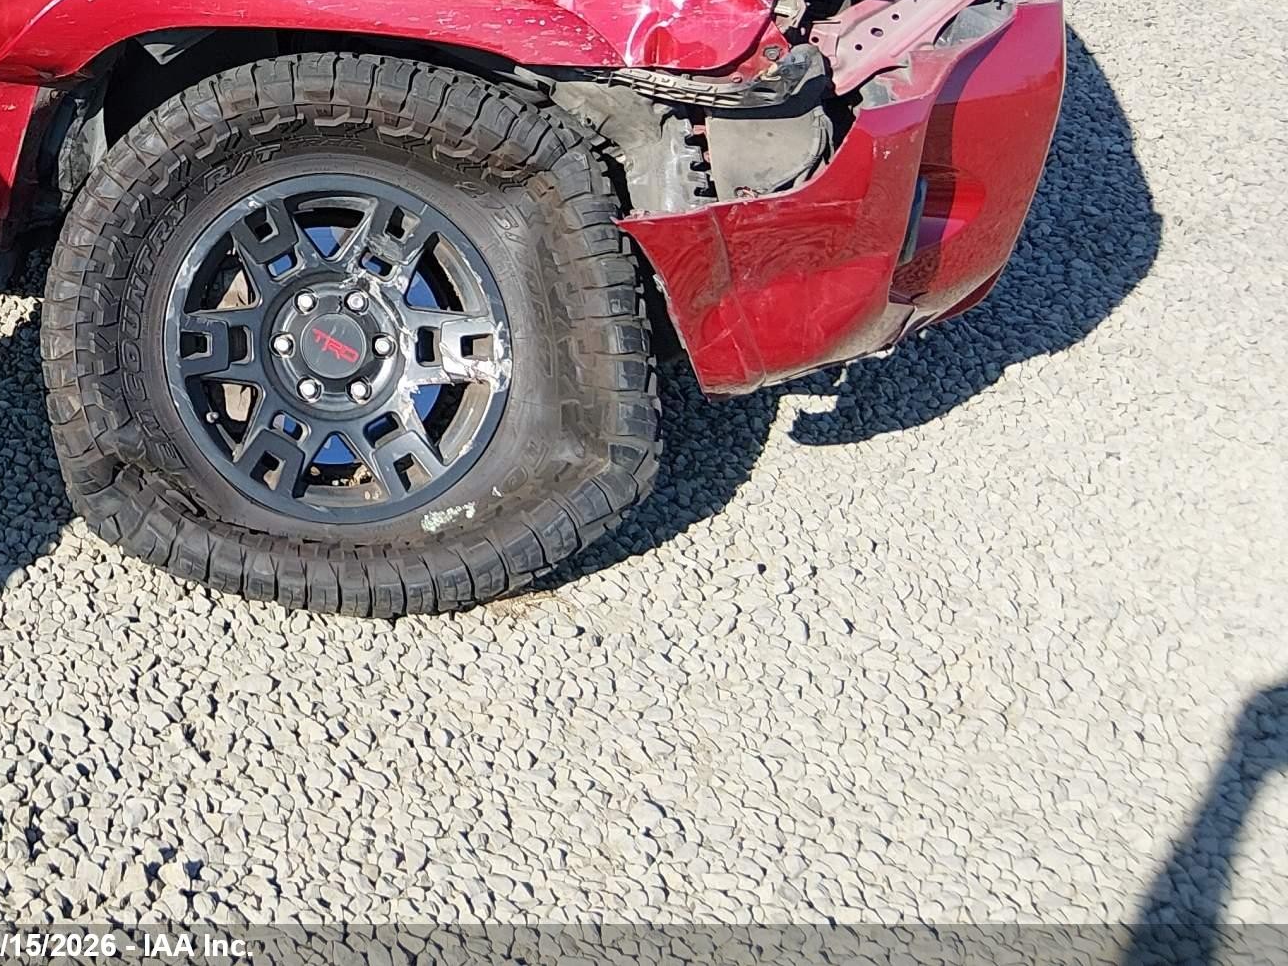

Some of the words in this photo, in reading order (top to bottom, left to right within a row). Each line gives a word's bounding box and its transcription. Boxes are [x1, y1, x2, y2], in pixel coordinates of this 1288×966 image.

[119, 194, 190, 402] COUNTRY
[203, 144, 282, 194] R/T
[311, 328, 360, 363] TRD
